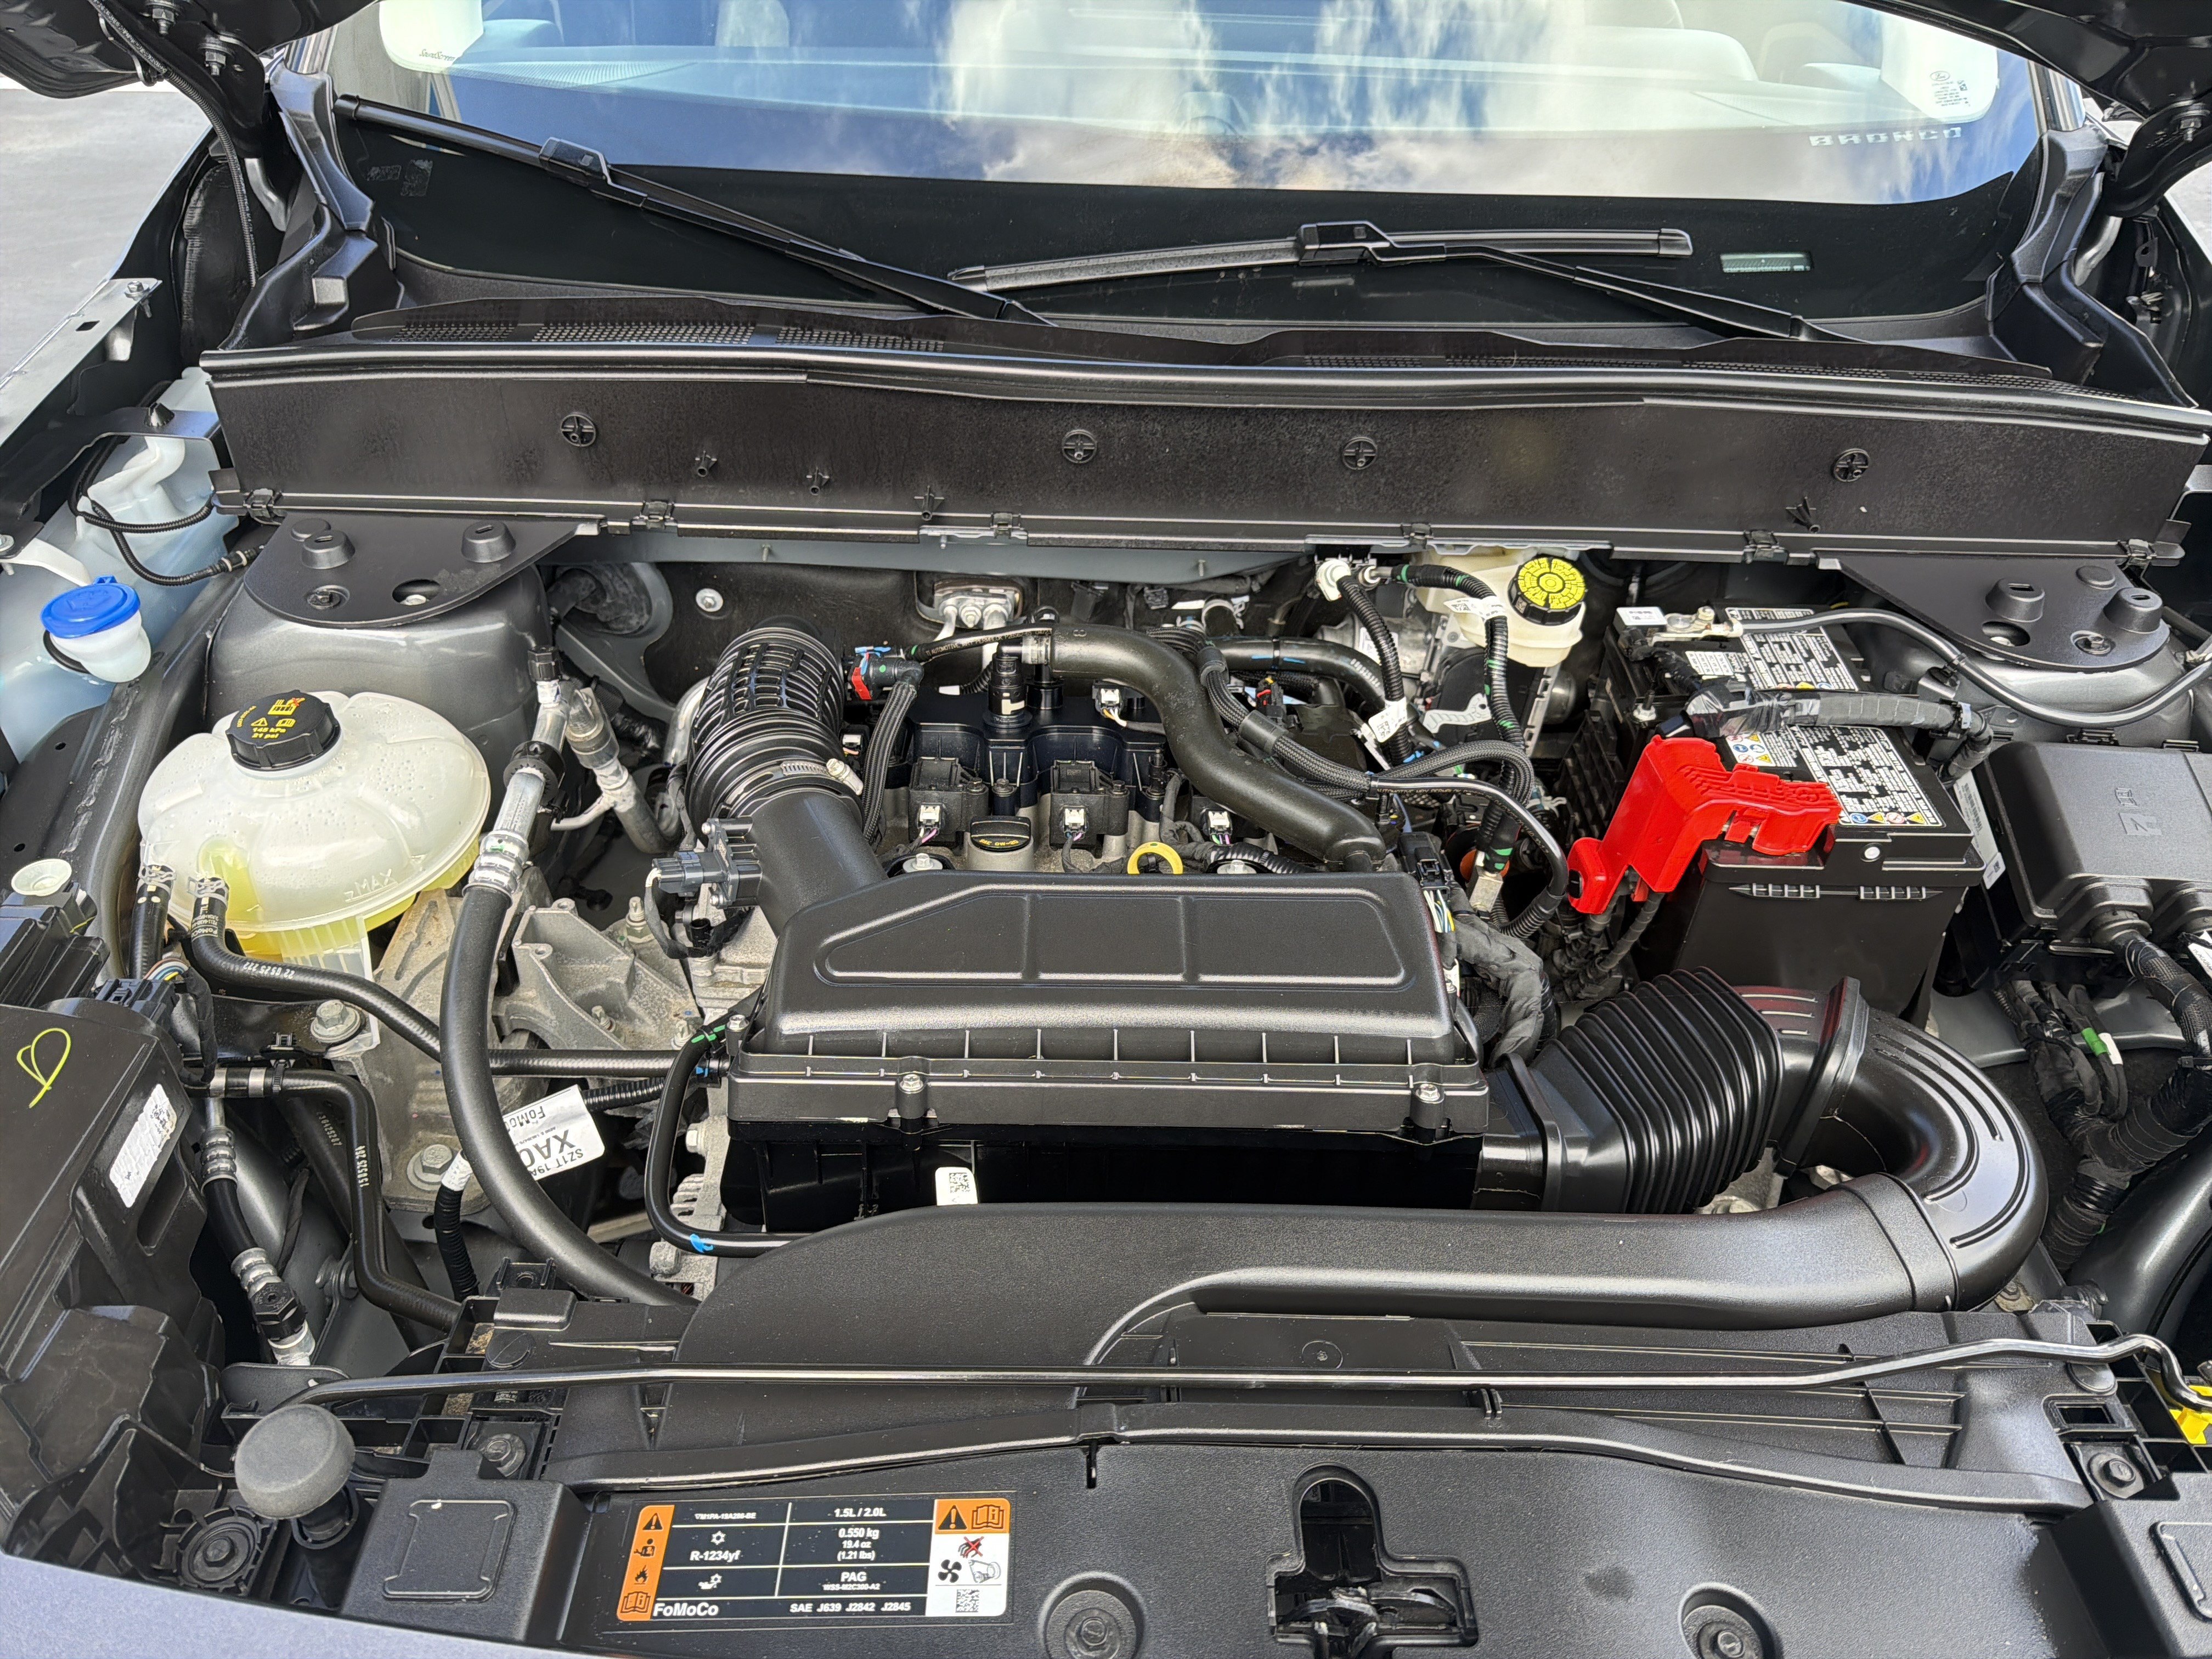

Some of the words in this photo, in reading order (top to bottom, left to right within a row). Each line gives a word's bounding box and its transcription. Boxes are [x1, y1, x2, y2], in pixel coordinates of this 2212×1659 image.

[1809, 127, 1962, 146] BRONCO
[354, 869, 398, 894] MAX
[834, 1509, 856, 1517] 1.5L
[863, 1508, 887, 1517] 2.0L
[838, 1528, 865, 1538] 0.550
[866, 1528, 879, 1539] kg
[842, 1541, 859, 1549] 19.4
[689, 1550, 741, 1563] R-1234yf
[837, 1551, 857, 1561] (1.21
[859, 1550, 876, 1561] lbs)
[840, 1572, 867, 1582] PAG
[653, 1602, 719, 1617] FoMoCo
[789, 1603, 812, 1613] SAE
[816, 1602, 842, 1612] J639
[845, 1602, 876, 1612] J2842
[881, 1601, 911, 1611] J2845
